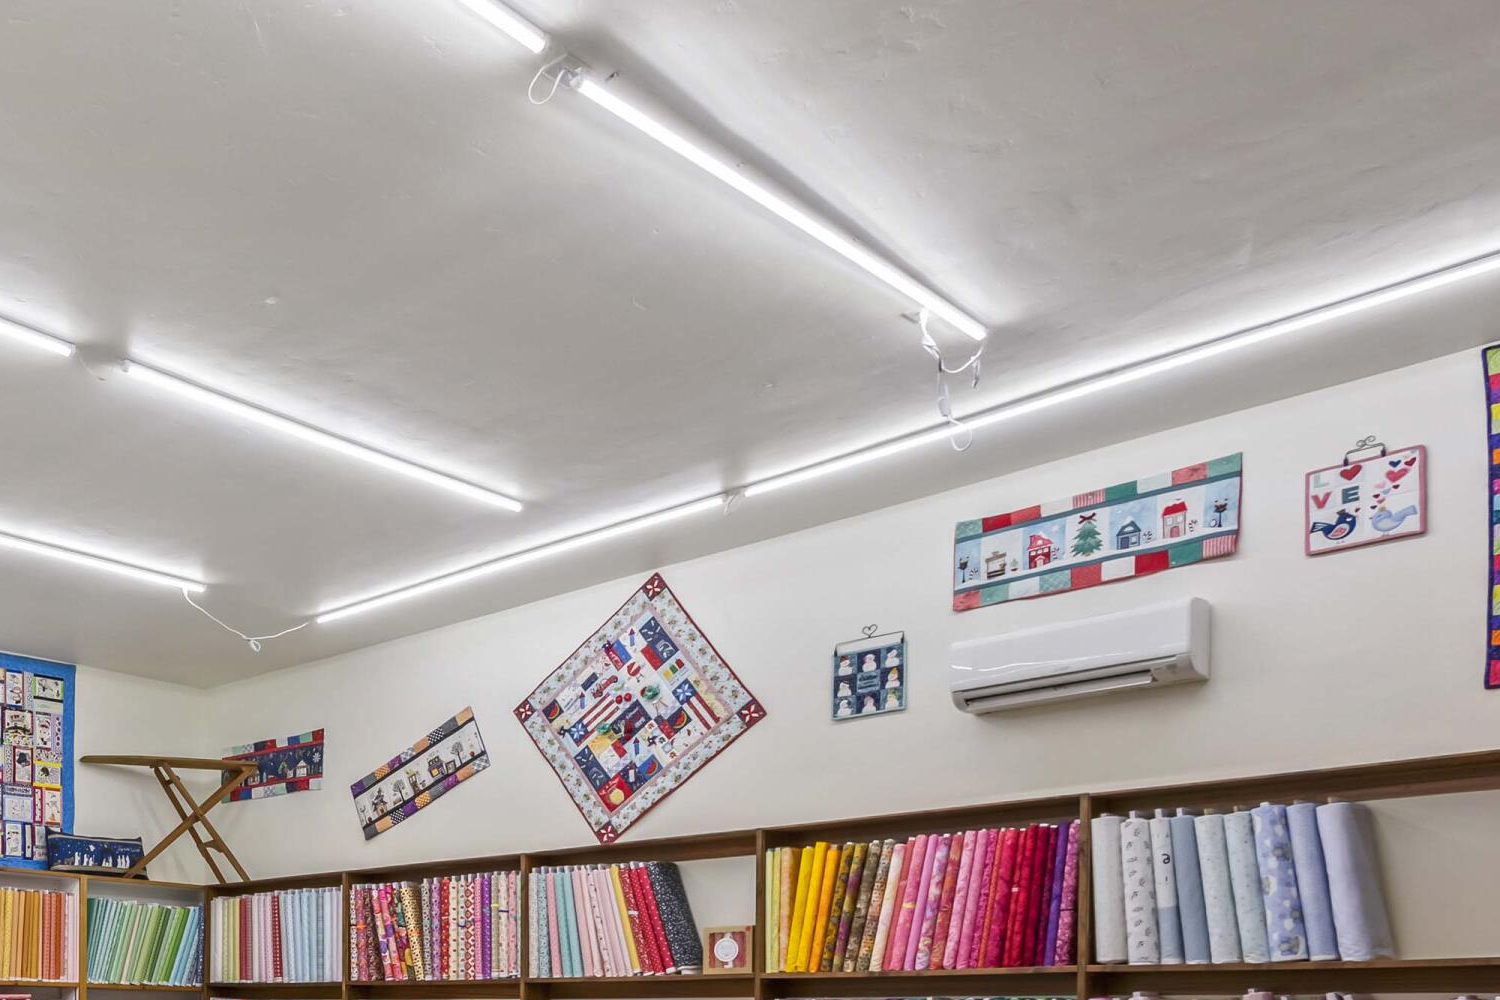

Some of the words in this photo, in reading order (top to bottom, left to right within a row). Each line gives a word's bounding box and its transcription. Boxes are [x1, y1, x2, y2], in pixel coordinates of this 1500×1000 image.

[1313, 474, 1329, 488] L
[1311, 491, 1332, 509] V
[1341, 485, 1360, 504] E
